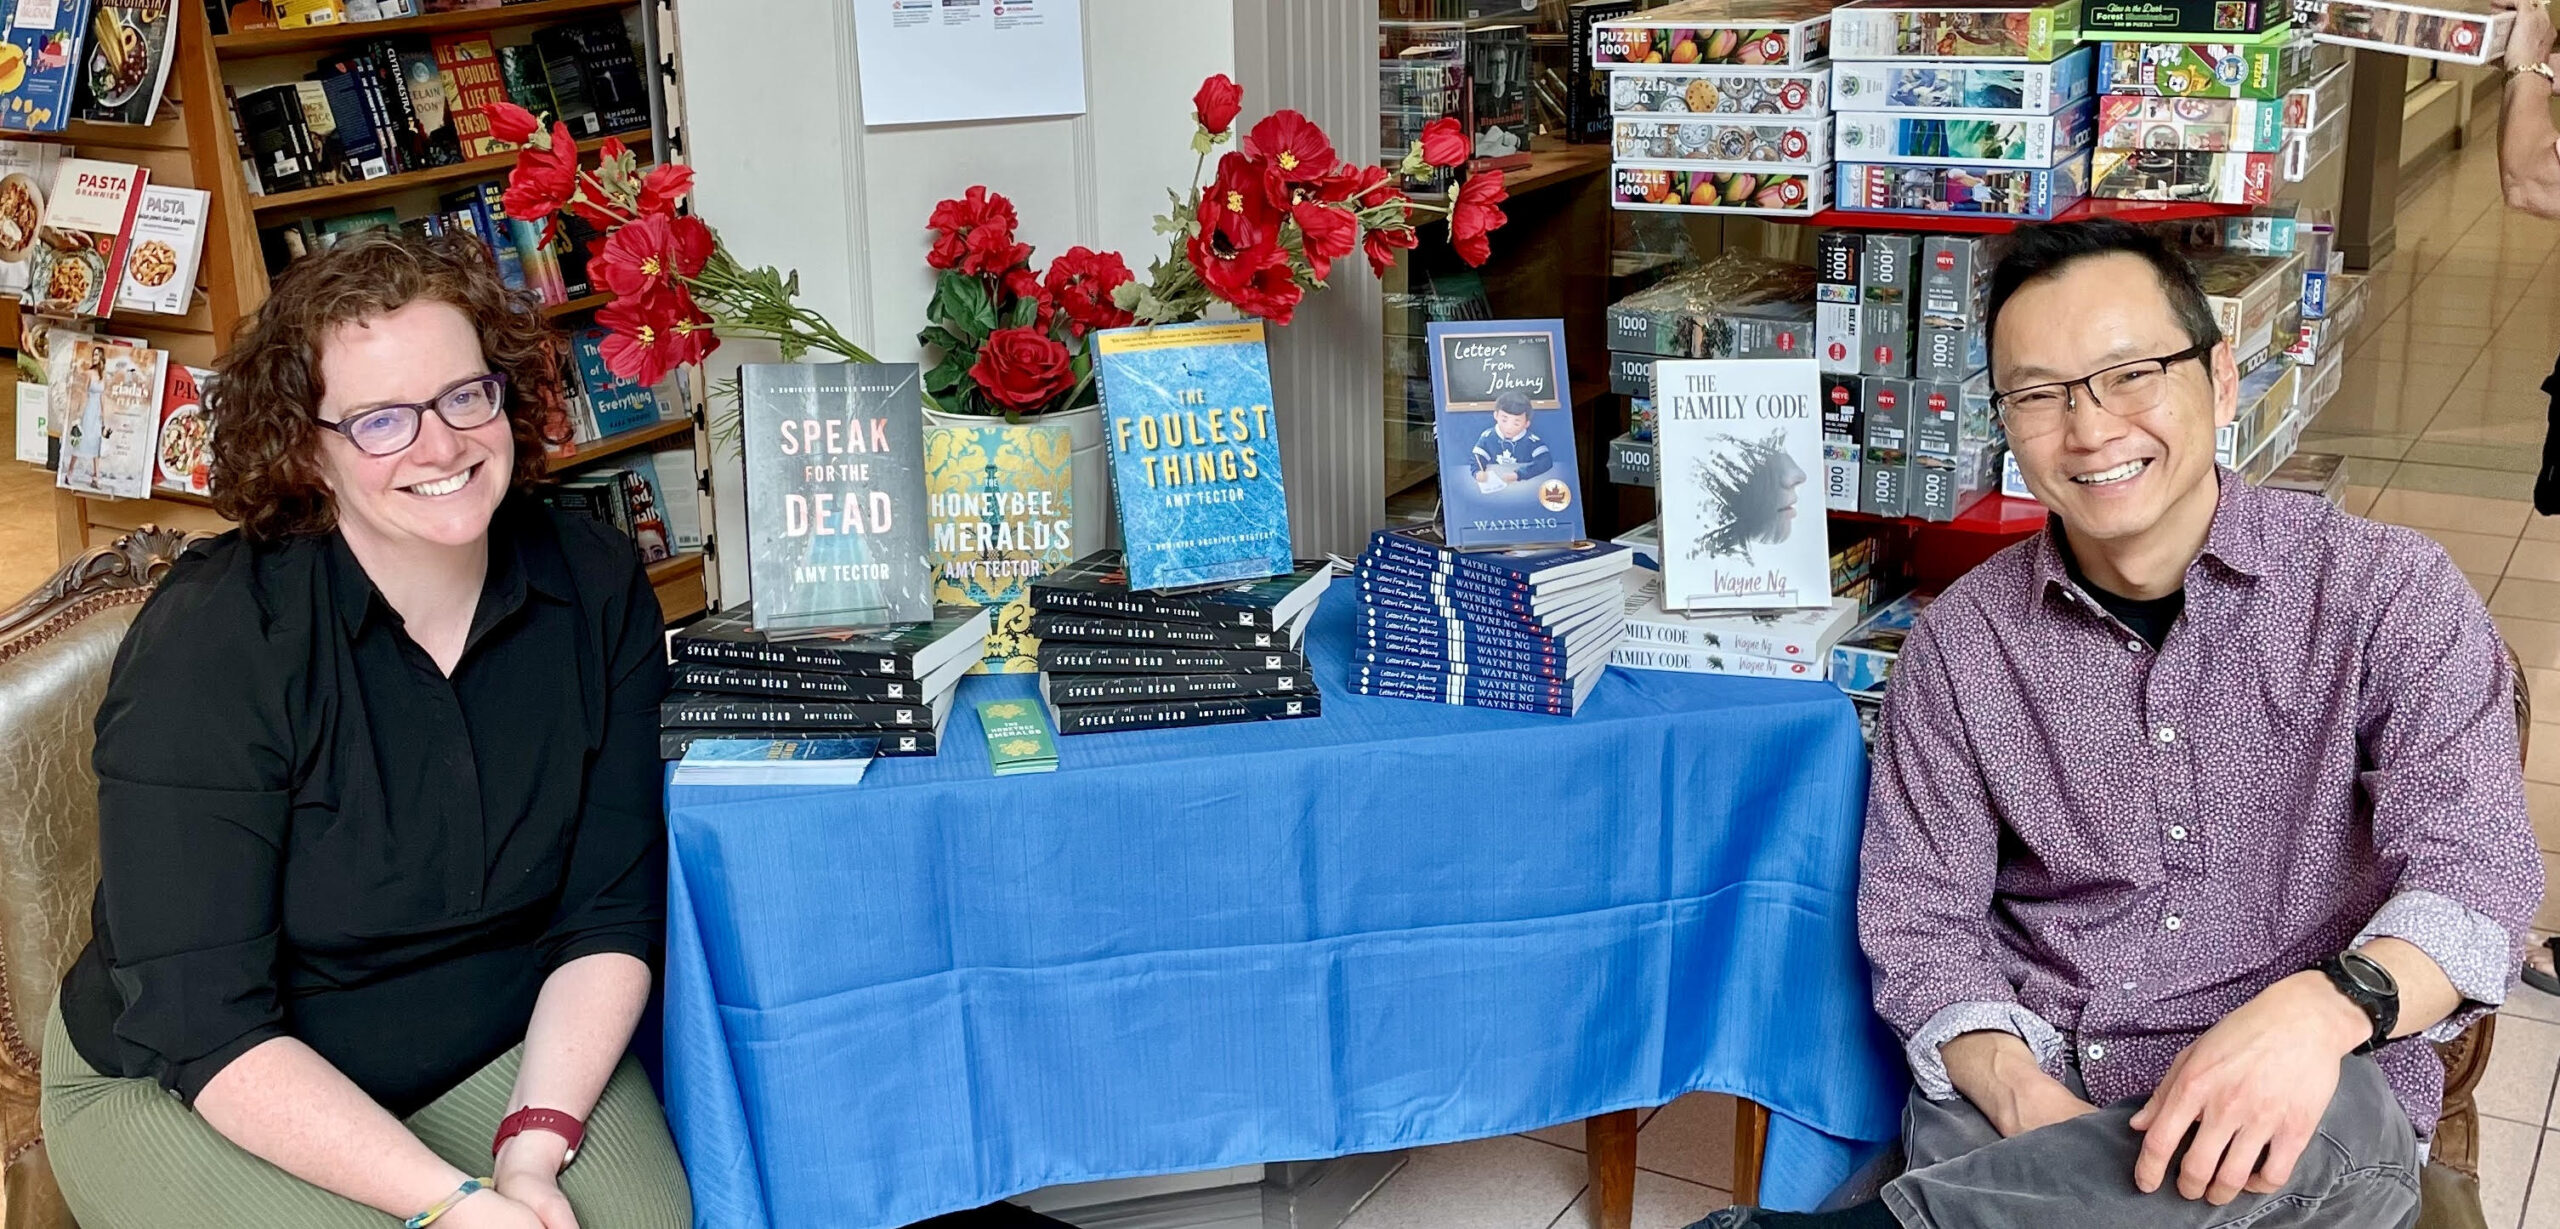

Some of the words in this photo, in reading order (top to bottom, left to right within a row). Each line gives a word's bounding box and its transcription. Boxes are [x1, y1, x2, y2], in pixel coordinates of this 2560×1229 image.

[2097, 12, 2124, 20] Forest
[1572, 20, 1580, 45] STEVE
[1600, 32, 1648, 43] PUZZLE
[1572, 47, 1580, 73] BERRY
[1600, 45, 1630, 55] 1000
[387, 47, 411, 114] CLYTEMNESTRA
[456, 62, 498, 86] DOUBLE
[1416, 63, 1453, 91] NEVER
[2253, 53, 2263, 88] PUZZLE
[464, 88, 486, 109] LIFE
[489, 86, 501, 103] OF
[1422, 89, 1460, 118] NEVER
[454, 113, 491, 135] ENSO
[1619, 126, 1669, 137] PUZZLE
[1620, 139, 1650, 150] 1000
[78, 173, 127, 192] PASTA
[1618, 172, 1666, 184] PUZZLE
[75, 188, 120, 200] GRANNIES
[1618, 185, 1649, 196] 1000
[2038, 171, 2048, 208] 1000
[146, 197, 185, 216] PASTA
[1833, 246, 1847, 280] 1000
[1880, 249, 1894, 283] 1000
[1936, 256, 1954, 265] HEYE
[1618, 316, 1647, 331] 1000
[1618, 330, 1647, 338] PUZZLE
[583, 343, 600, 357] Th
[1454, 341, 1507, 359] Letters
[1933, 334, 1948, 368] 1000
[2247, 348, 2268, 372] 1000
[590, 366, 599, 376] of
[1483, 358, 1516, 371] From
[1621, 361, 1650, 376] 1000
[1486, 373, 1544, 395] Johnny
[1685, 375, 1716, 393] THE
[598, 391, 652, 414] Everything
[1177, 389, 1205, 404] THE
[1831, 391, 1849, 400] HEYE
[1878, 396, 1895, 404] HEYE
[1928, 399, 1946, 407] HEYE
[1672, 395, 1747, 420] FAMILY
[1756, 394, 1810, 419] CODE
[780, 418, 890, 456] SPEAK
[1116, 404, 1268, 452] FOULEST
[1141, 448, 1259, 488] THINGS
[1620, 450, 1650, 466] 1000
[805, 465, 835, 483] FOR
[840, 463, 870, 482] THE
[1831, 466, 1844, 497] 1000
[1875, 470, 1890, 503] 1000
[1925, 474, 1940, 507] 1000
[931, 490, 1055, 518] HONEYBEE
[1165, 493, 1192, 508] AMY
[1196, 488, 1245, 505] TECTOR
[785, 491, 893, 538] DEAD
[1473, 519, 1531, 531] WAYNE
[1534, 518, 1558, 529] NG
[795, 565, 827, 584] AMY
[832, 563, 890, 582] TECTOR
[946, 561, 978, 579] AMY
[985, 559, 1040, 578] TECTOR
[1460, 558, 1488, 572] WAYNE
[1490, 564, 1502, 575] NG
[1713, 569, 1761, 597] Wayne
[1767, 569, 1787, 595] Ng
[1046, 595, 1078, 606] SPEAK
[1100, 601, 1113, 609] THE
[1118, 601, 1144, 613] DEAD
[1155, 607, 1170, 615] AMY
[1173, 608, 1200, 618] TECTOR
[1476, 635, 1512, 649] WAYNE
[1515, 641, 1531, 651] NG
[1625, 624, 1654, 641] MILY
[1657, 627, 1689, 644] CODE
[1735, 635, 1756, 650] Wayne
[1761, 639, 1772, 653] Ng
[687, 644, 720, 657] SPEAK
[725, 650, 739, 658] FOR
[741, 651, 754, 660] THE
[759, 652, 785, 663] DEAD
[796, 656, 811, 664] AMY
[814, 657, 841, 666] TECTOR
[1610, 649, 1656, 666] FAMILY
[1659, 651, 1692, 668] CODE
[1739, 657, 1762, 672] Wayne
[1766, 661, 1777, 674] Ng
[1481, 667, 1518, 680] WAYNE
[1521, 673, 1536, 683] NG
[680, 711, 717, 721] SPEAK
[723, 713, 738, 721] FOR
[742, 713, 756, 721] THE
[761, 711, 791, 722] DEAD
[804, 713, 820, 721] AMY
[823, 713, 853, 721] TECTOR
[1079, 715, 1115, 727] SPEAK
[1120, 714, 1135, 722] FOR
[1138, 713, 1152, 722] THE
[1158, 711, 1186, 722] DEAD
[1199, 710, 1214, 718] AMY
[1217, 708, 1246, 717] TECTOR
